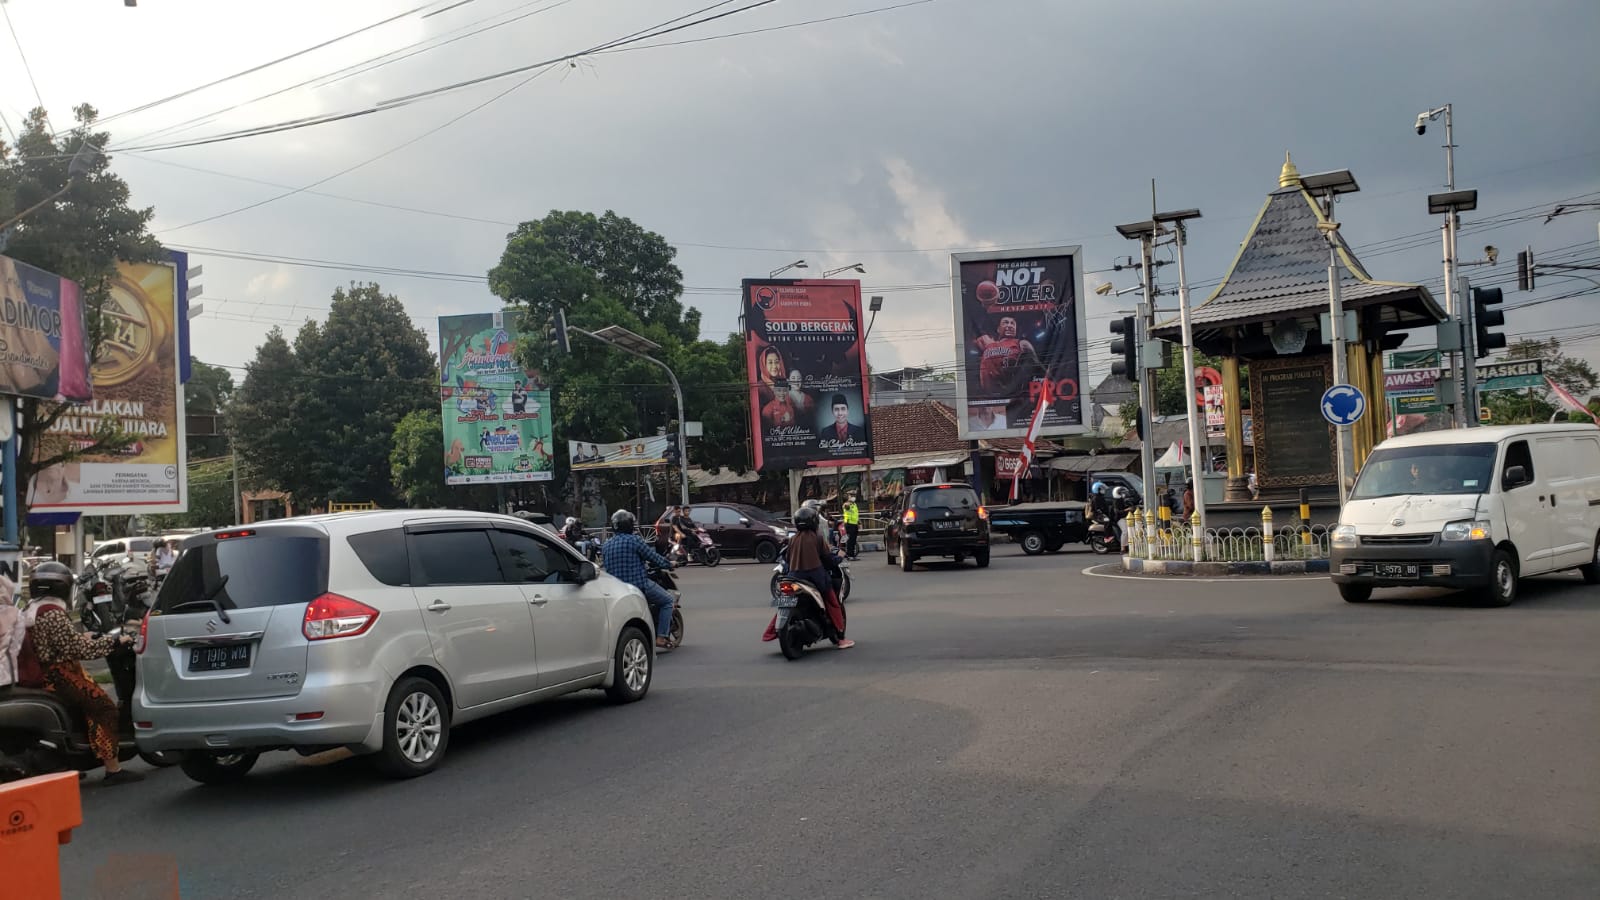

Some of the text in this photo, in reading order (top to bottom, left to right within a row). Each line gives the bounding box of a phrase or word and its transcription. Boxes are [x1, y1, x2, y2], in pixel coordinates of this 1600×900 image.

[996, 267, 1046, 286] NOT
[997, 284, 1055, 305] OVER
[765, 321, 855, 332] SOLID BERGERAK
[1476, 363, 1539, 379] MASKER
[120, 419, 168, 437] JUARA
[192, 646, 247, 664] B 1916 WYA
